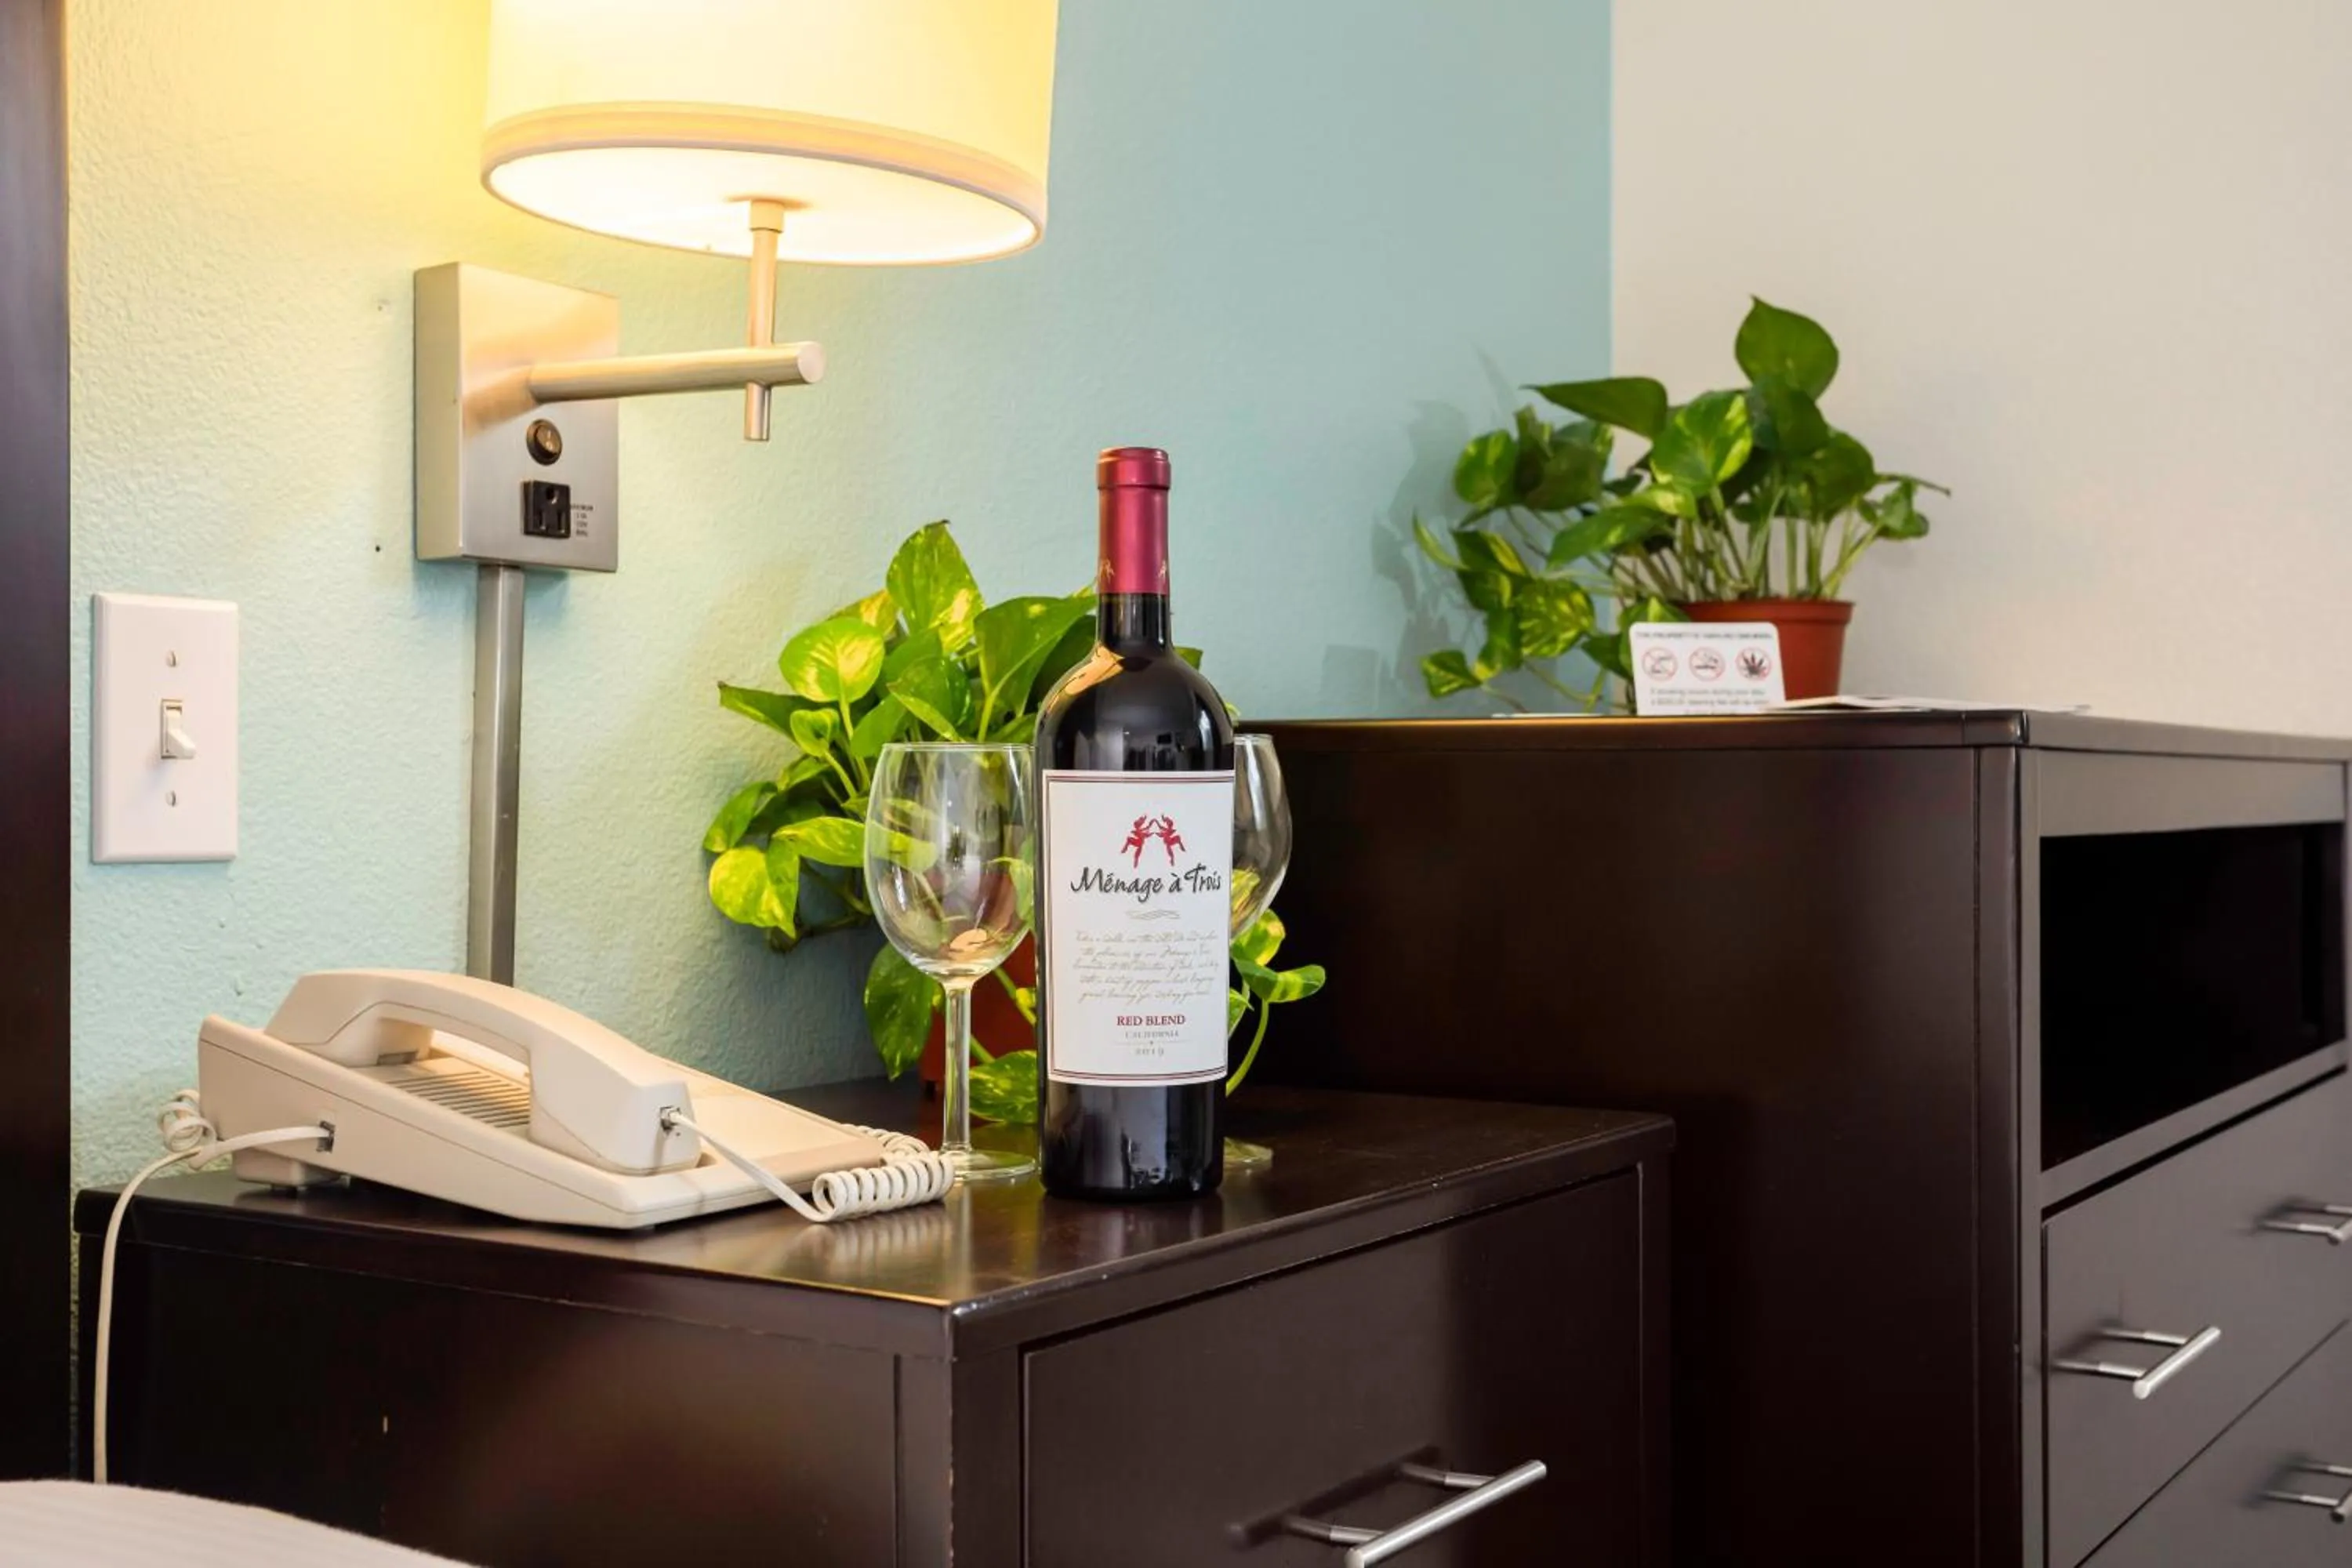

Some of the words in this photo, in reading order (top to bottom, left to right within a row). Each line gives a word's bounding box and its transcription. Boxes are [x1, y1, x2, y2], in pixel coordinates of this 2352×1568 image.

[1070, 866, 1163, 903] Ménage
[1168, 873, 1182, 894] à
[1184, 862, 1221, 894] Trois
[1116, 1015, 1143, 1026] RED
[1145, 1014, 1185, 1026] BLEND
